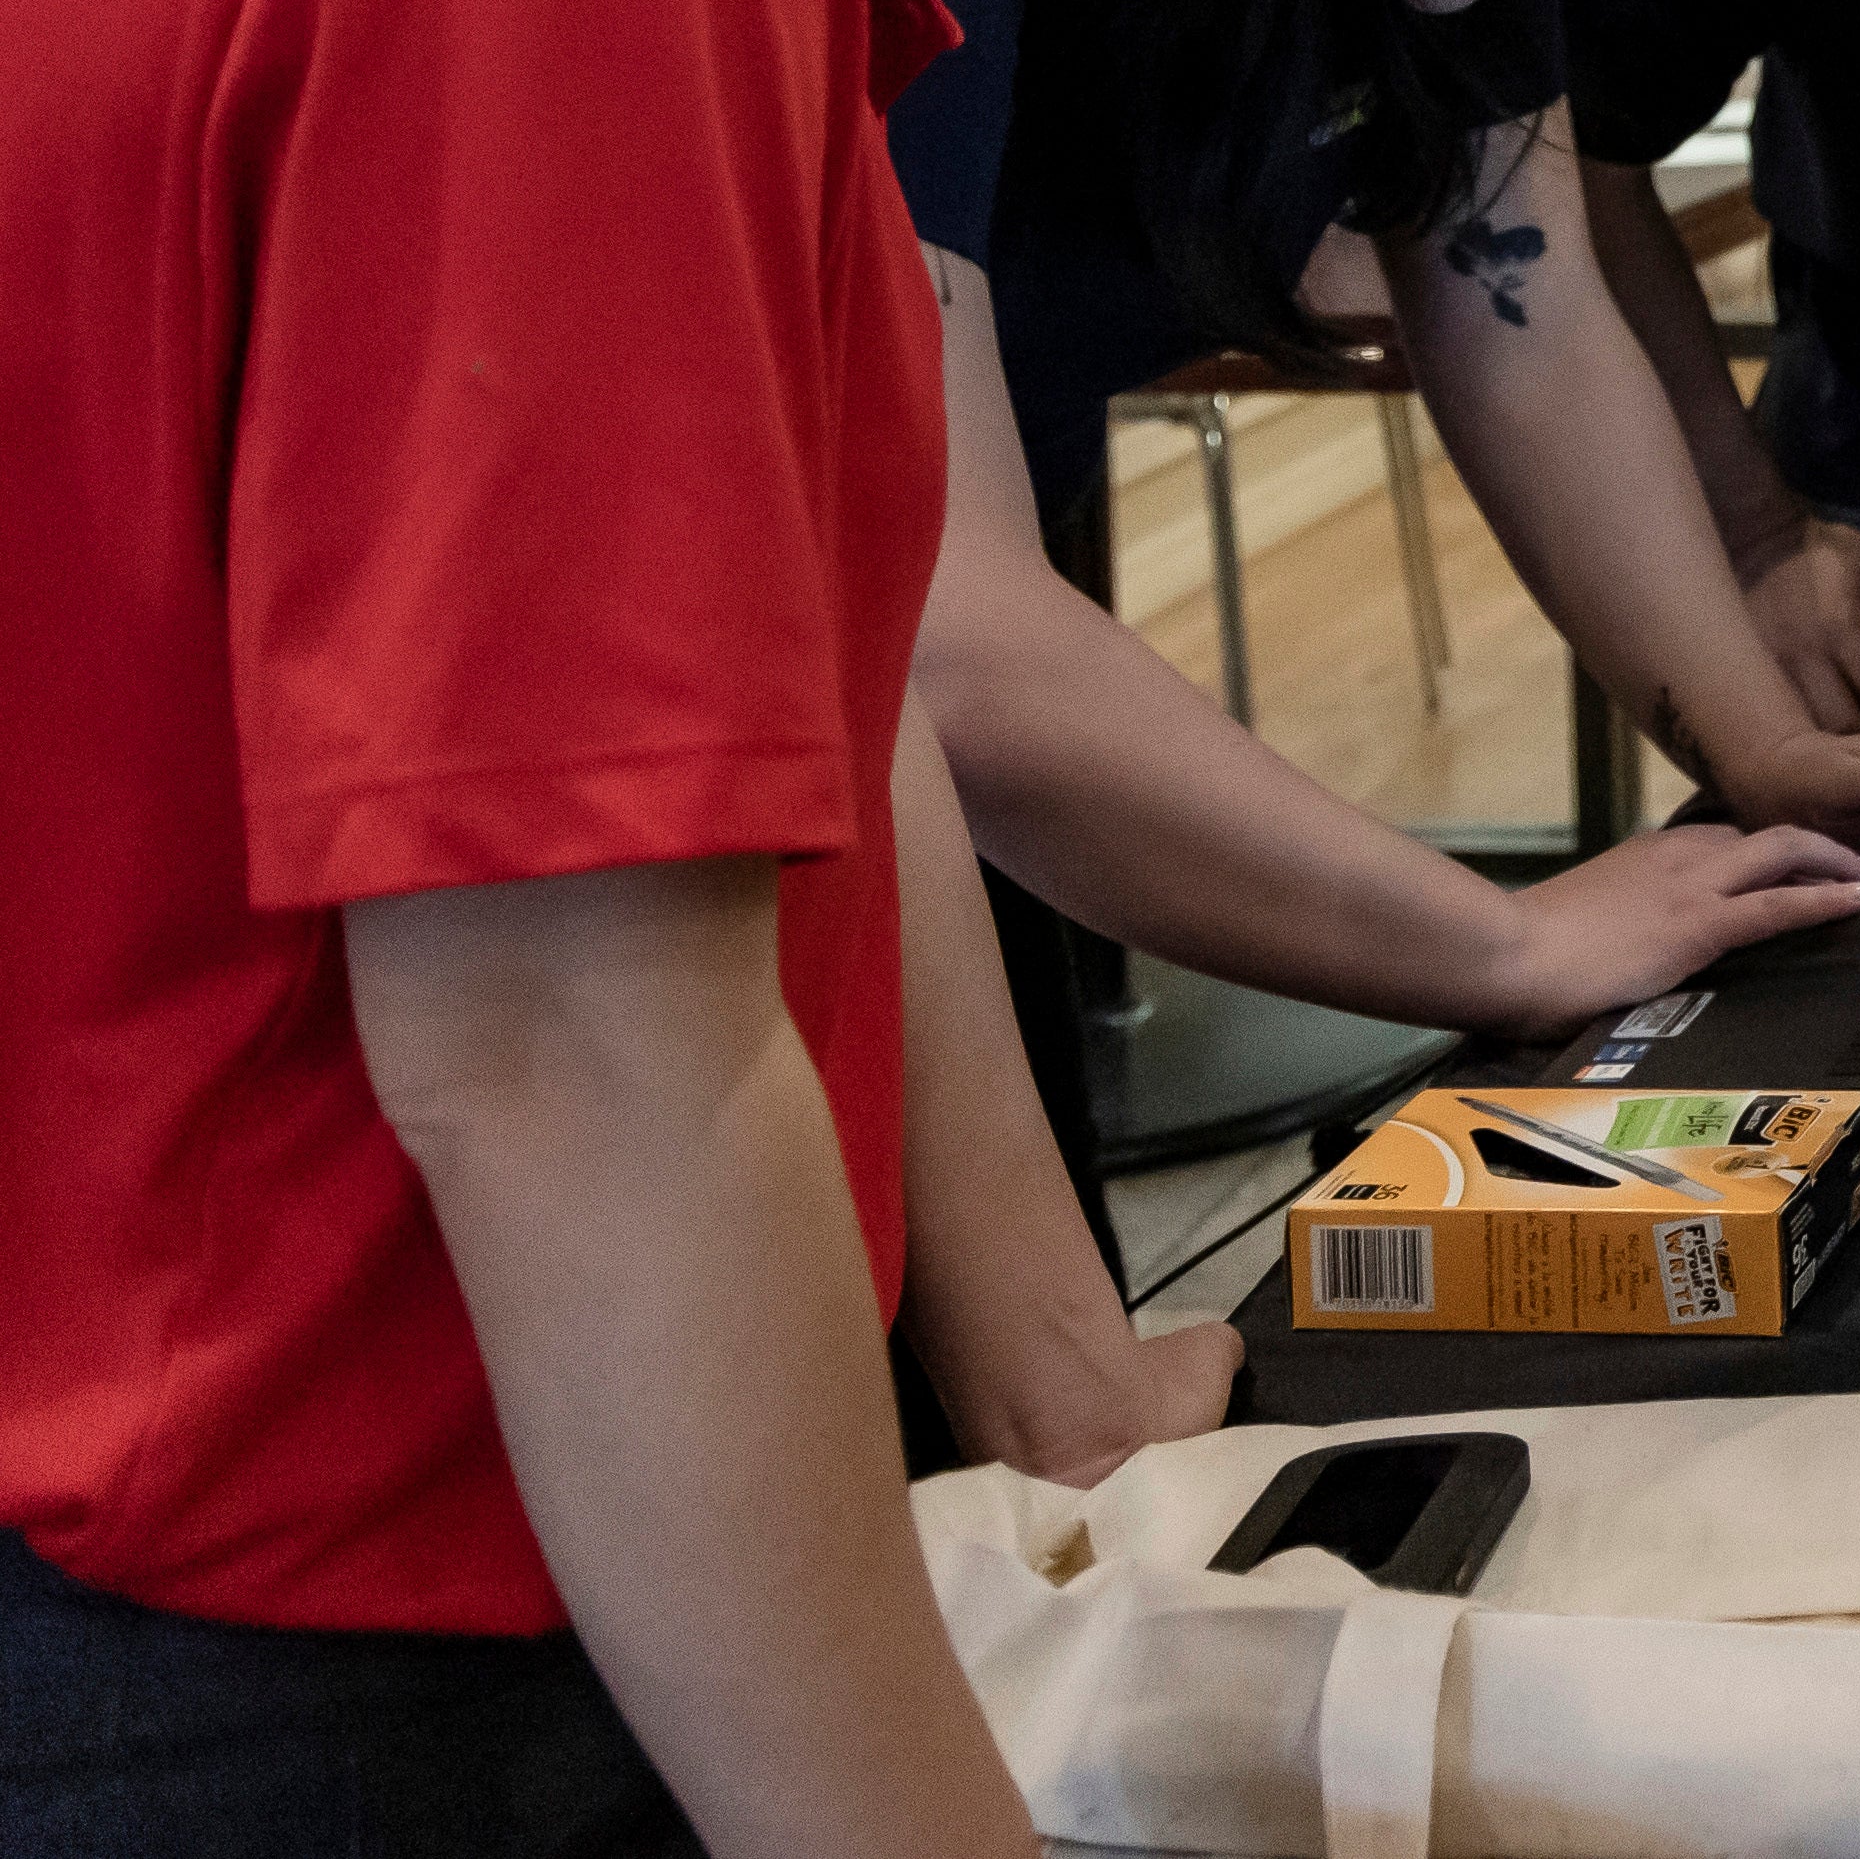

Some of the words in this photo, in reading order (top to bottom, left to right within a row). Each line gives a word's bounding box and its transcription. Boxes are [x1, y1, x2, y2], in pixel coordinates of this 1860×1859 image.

[1772, 1105, 1815, 1141] BIC
[1371, 1183, 1408, 1200] 36
[1686, 1247, 1704, 1288] YOUR
[1700, 1278, 1721, 1316] FOR
